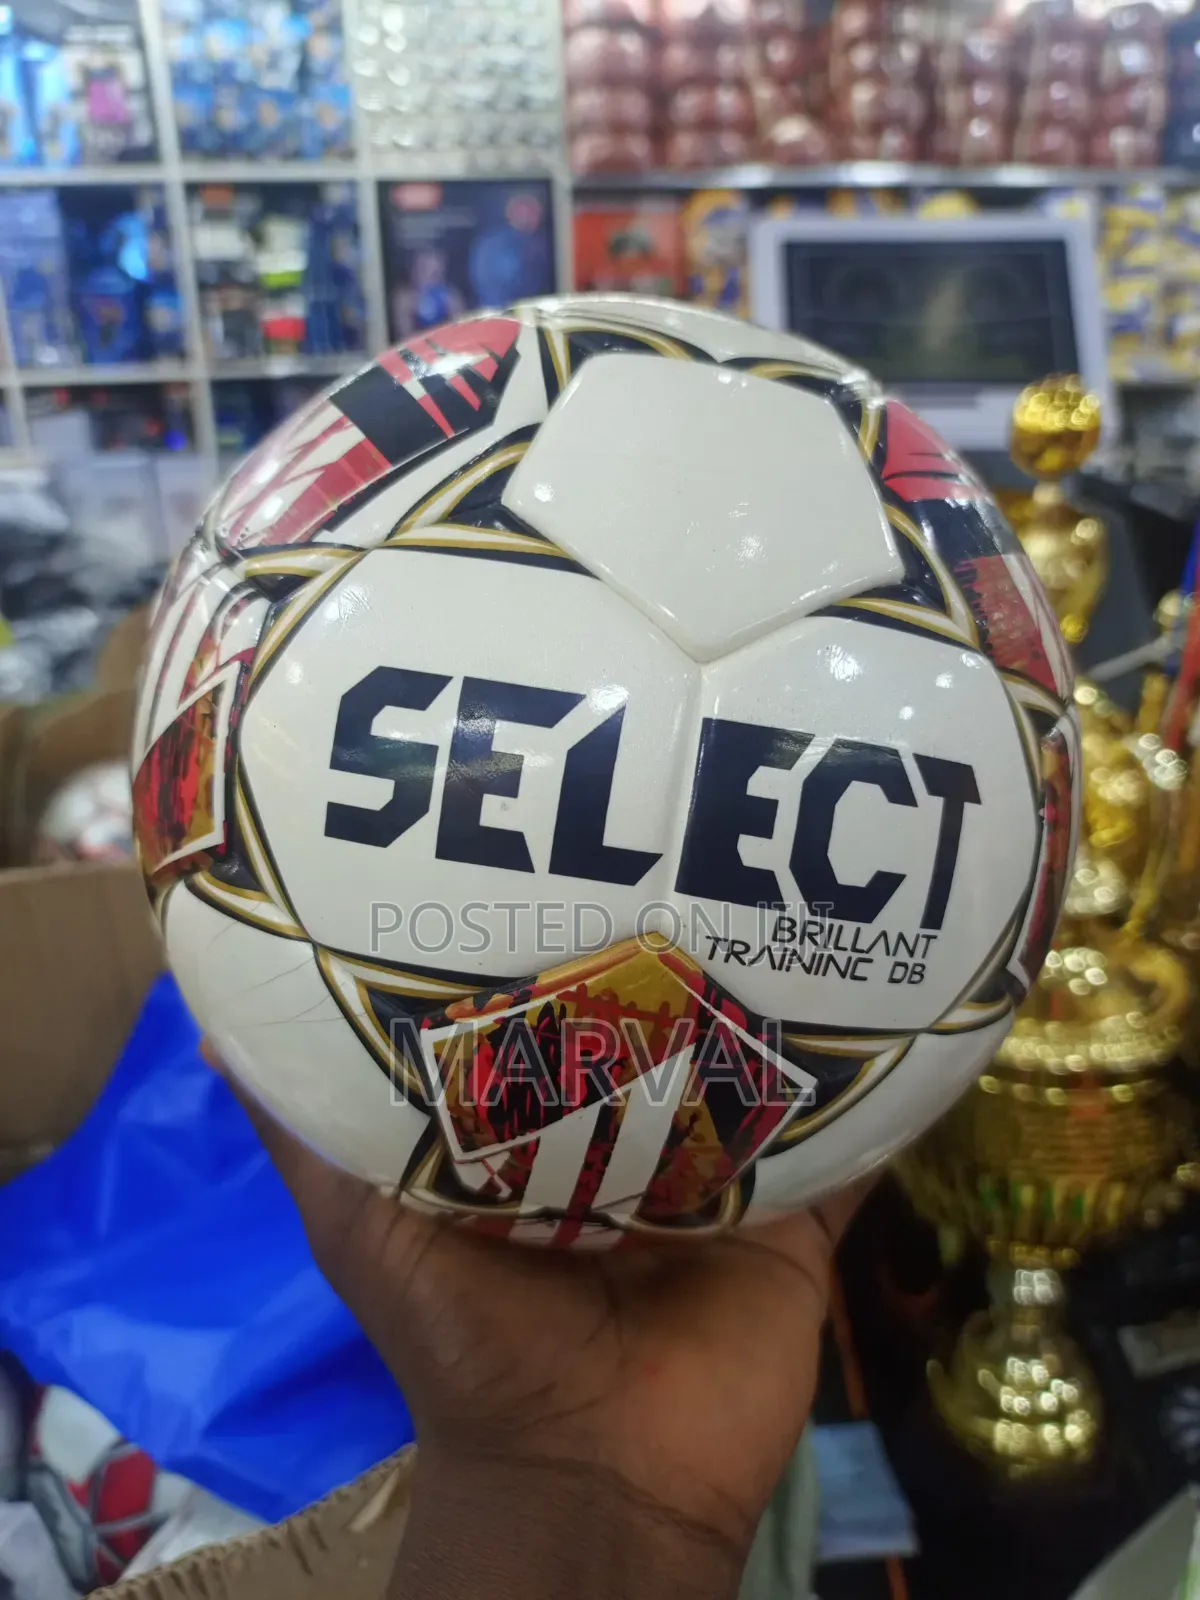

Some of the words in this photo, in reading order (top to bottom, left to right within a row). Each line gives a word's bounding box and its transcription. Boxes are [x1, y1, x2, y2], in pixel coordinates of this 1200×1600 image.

[324, 665, 982, 930] SELECT
[772, 915, 938, 959] BRILLANT
[887, 961, 925, 984] DB
